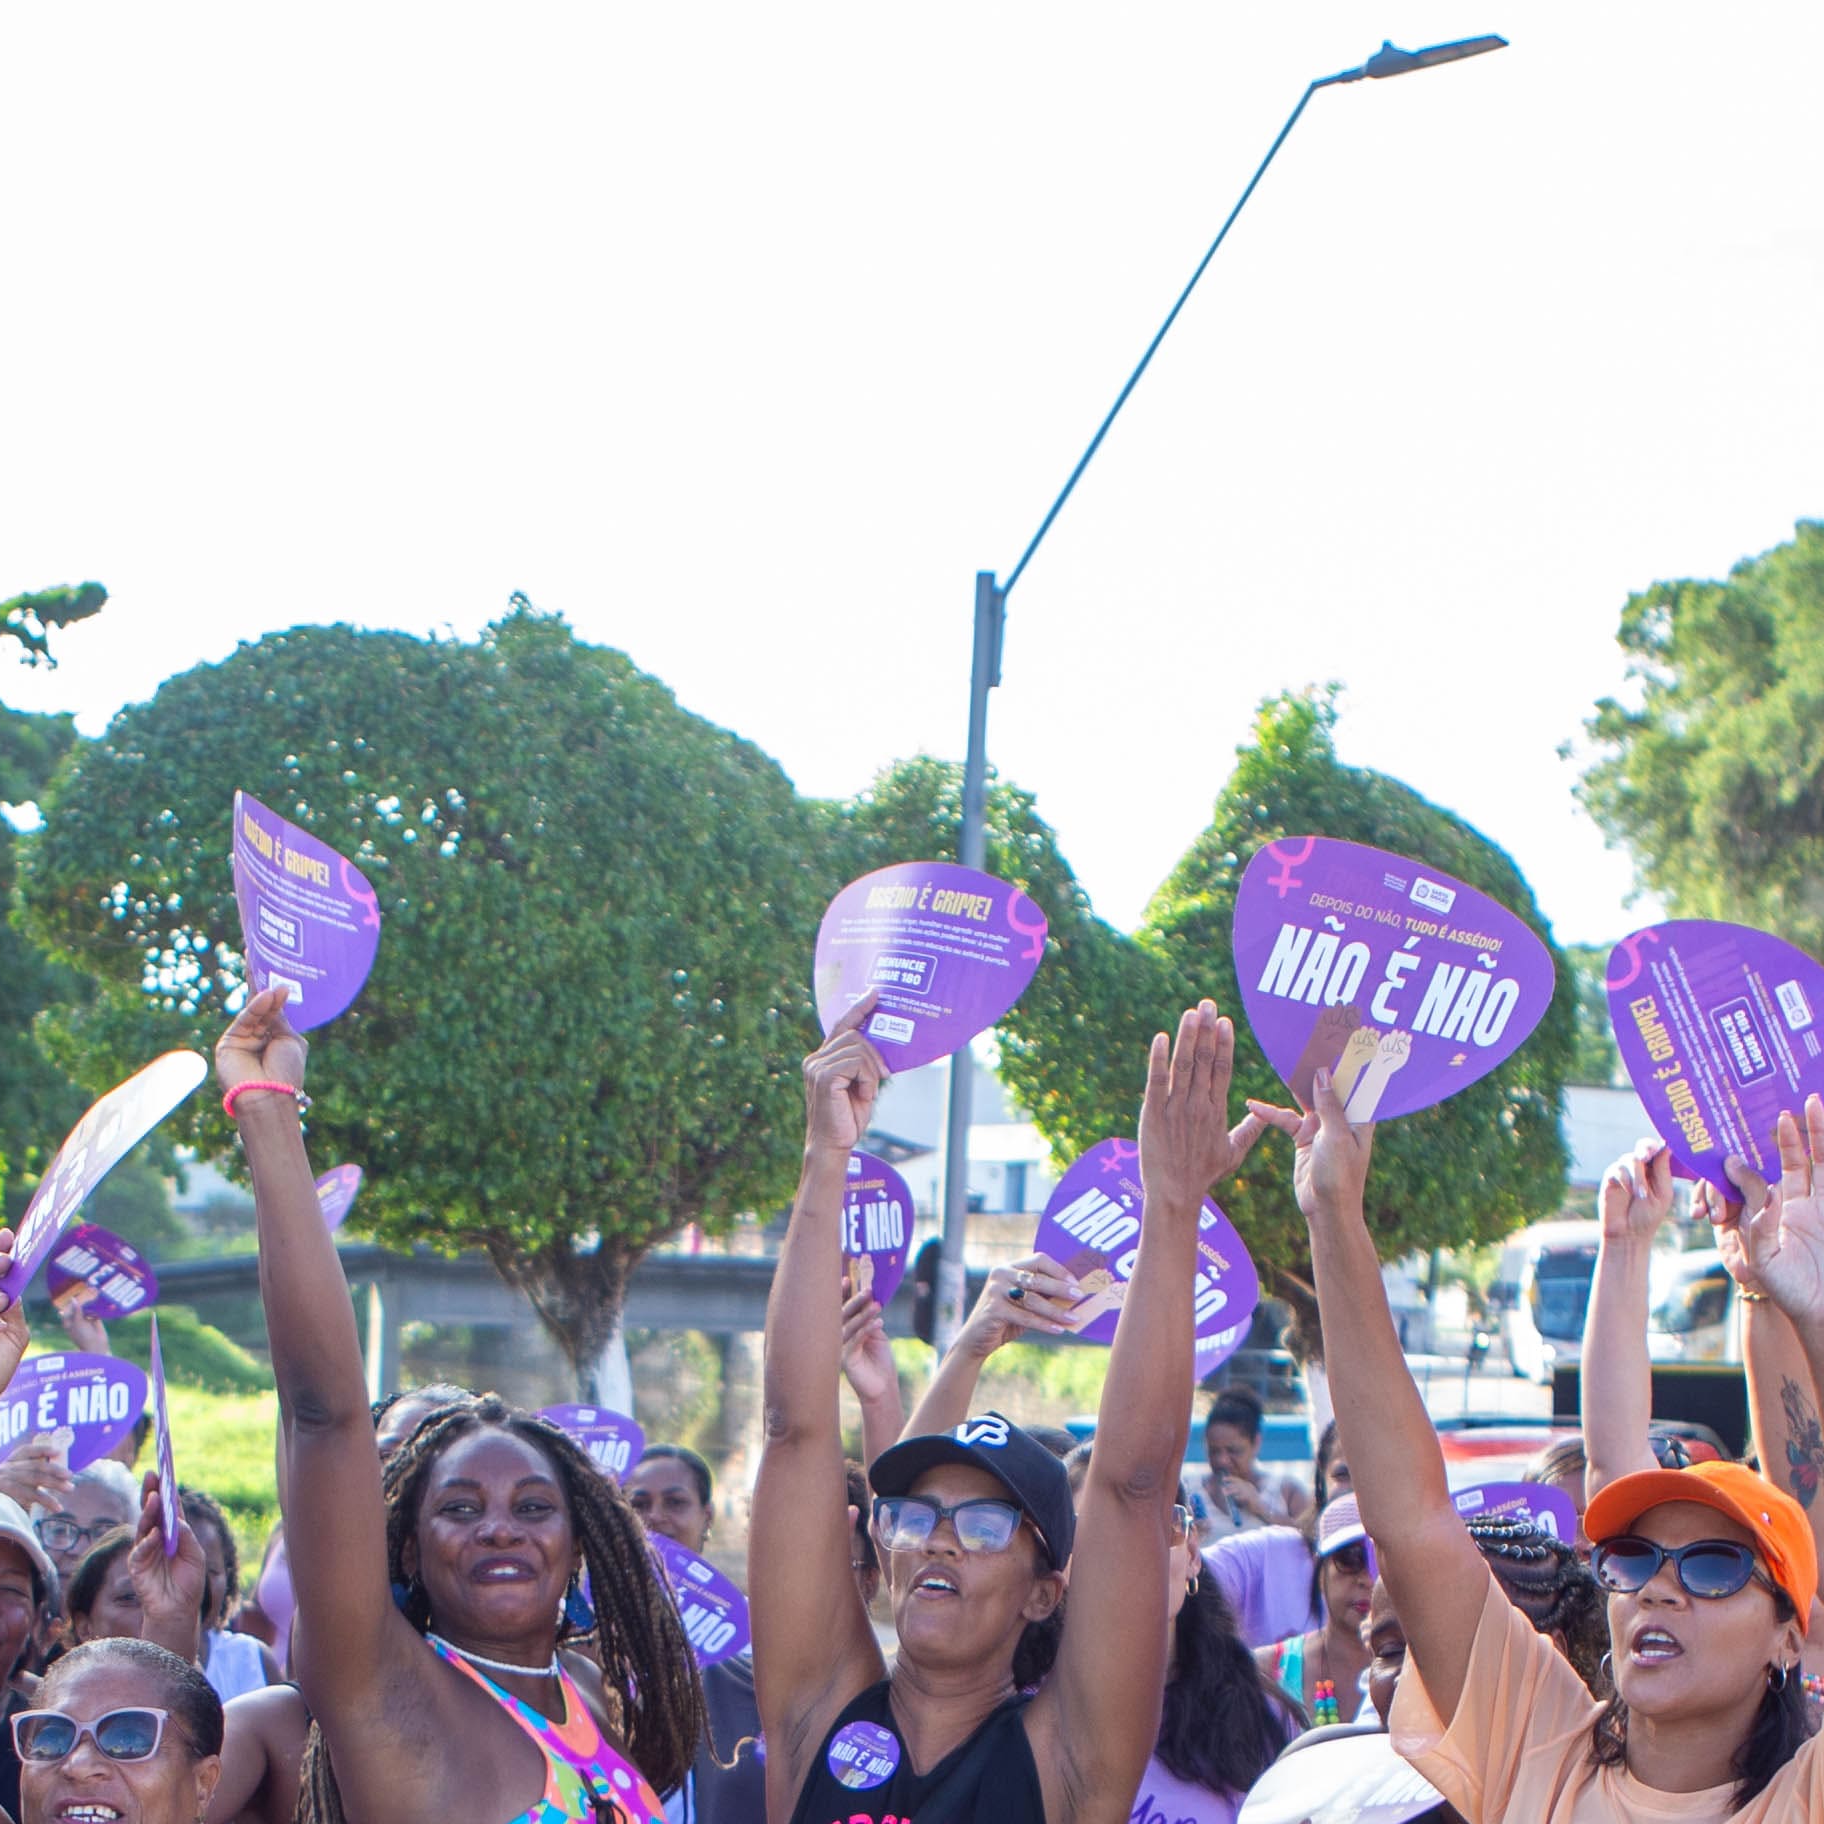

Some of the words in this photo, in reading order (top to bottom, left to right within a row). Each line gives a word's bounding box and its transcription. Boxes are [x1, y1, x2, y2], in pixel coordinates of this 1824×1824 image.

[284, 847, 330, 888] CRIME!
[918, 881, 932, 910] É
[932, 889, 993, 922] CRIME!
[1309, 892, 1353, 915] DEPOIS
[1355, 904, 1374, 920] DO
[1375, 908, 1402, 929] NÃO,
[1405, 918, 1437, 938] TUDO
[1438, 924, 1449, 940] É
[1449, 927, 1503, 952] ASSÉDIO!
[901, 973, 922, 985] 180
[1256, 915, 1371, 1007] NÃO
[1370, 936, 1422, 1025] É
[1411, 953, 1520, 1048] NÃO
[1629, 994, 1675, 1062] CRIME!
[1720, 1013, 1754, 1077] DENUNCIE
[1733, 1009, 1751, 1034] 180
[1652, 1060, 1682, 1081] É
[1742, 1035, 1767, 1071] LIGUE
[1665, 1077, 1715, 1154] ASSÉDIO
[849, 1192, 862, 1252] É
[865, 1189, 904, 1251] NÃO
[1052, 1186, 1140, 1253] NÃO
[101, 1272, 146, 1309] NÃO
[37, 1383, 58, 1429] É
[68, 1376, 129, 1425] NÃO
[830, 1740, 858, 1762] NÃO
[855, 1749, 871, 1767] É
[865, 1756, 894, 1776] NÃO
